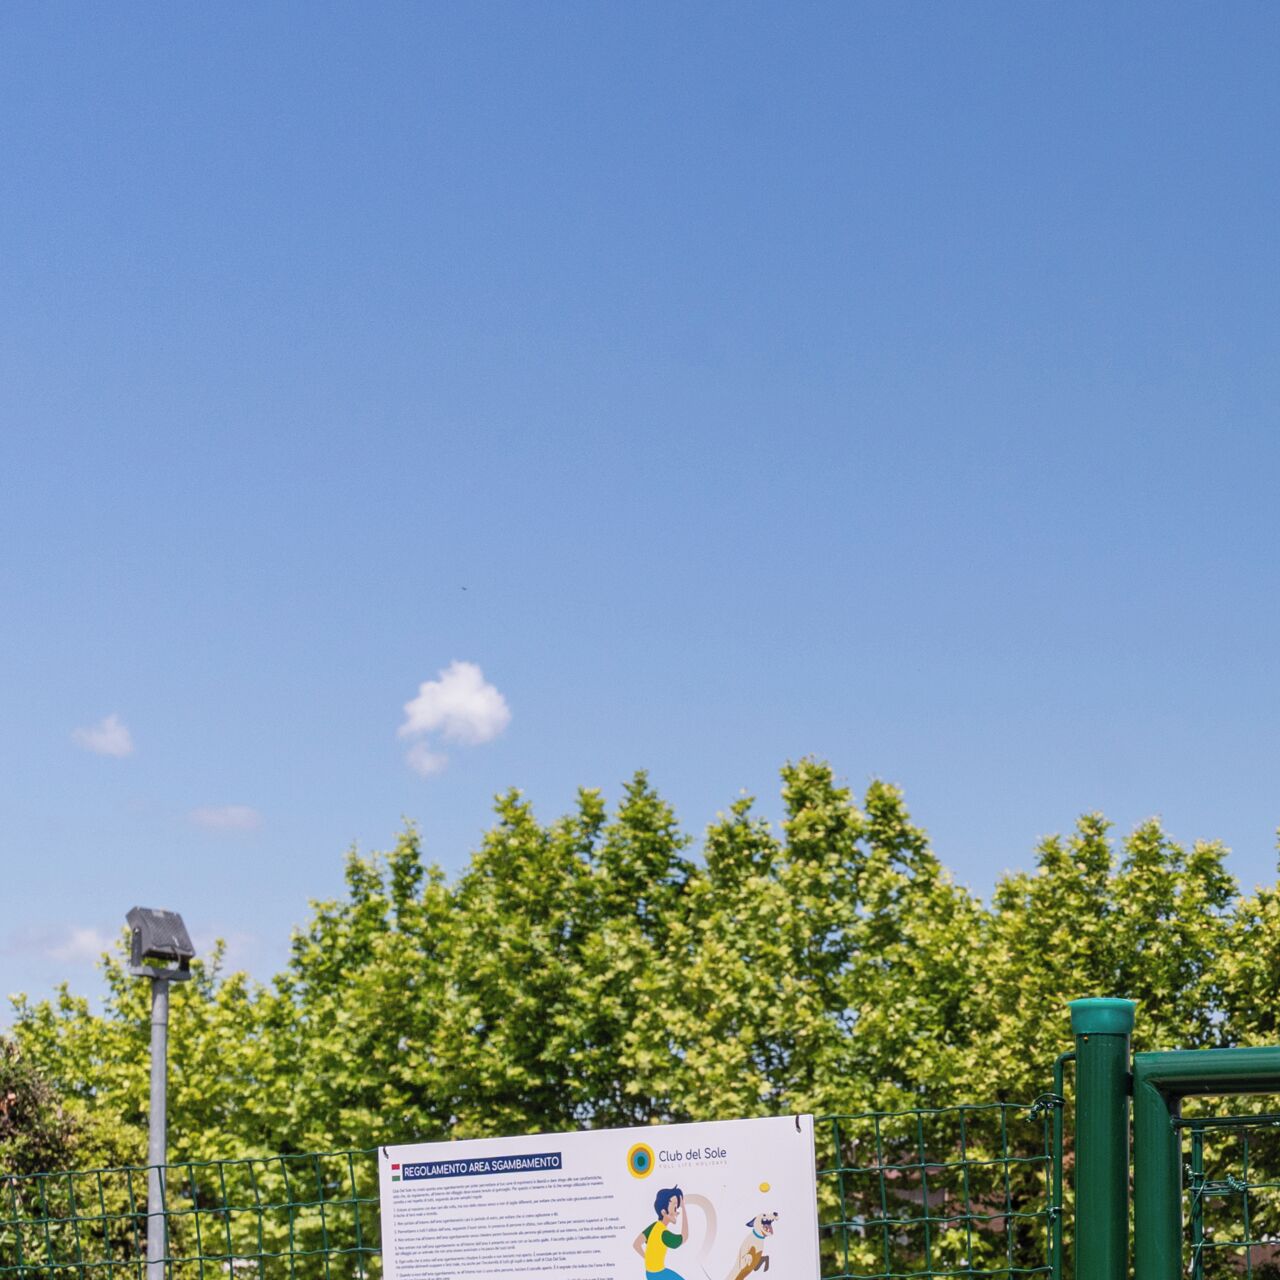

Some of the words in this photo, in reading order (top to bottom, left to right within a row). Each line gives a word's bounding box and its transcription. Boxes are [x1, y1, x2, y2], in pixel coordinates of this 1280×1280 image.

[658, 1150, 683, 1162] Club
[685, 1148, 702, 1160] del
[704, 1147, 727, 1159] Sole
[404, 1163, 467, 1177] REGOLAMENTO
[468, 1161, 491, 1172] AREA
[491, 1156, 560, 1171] SGAMBAMENTO
